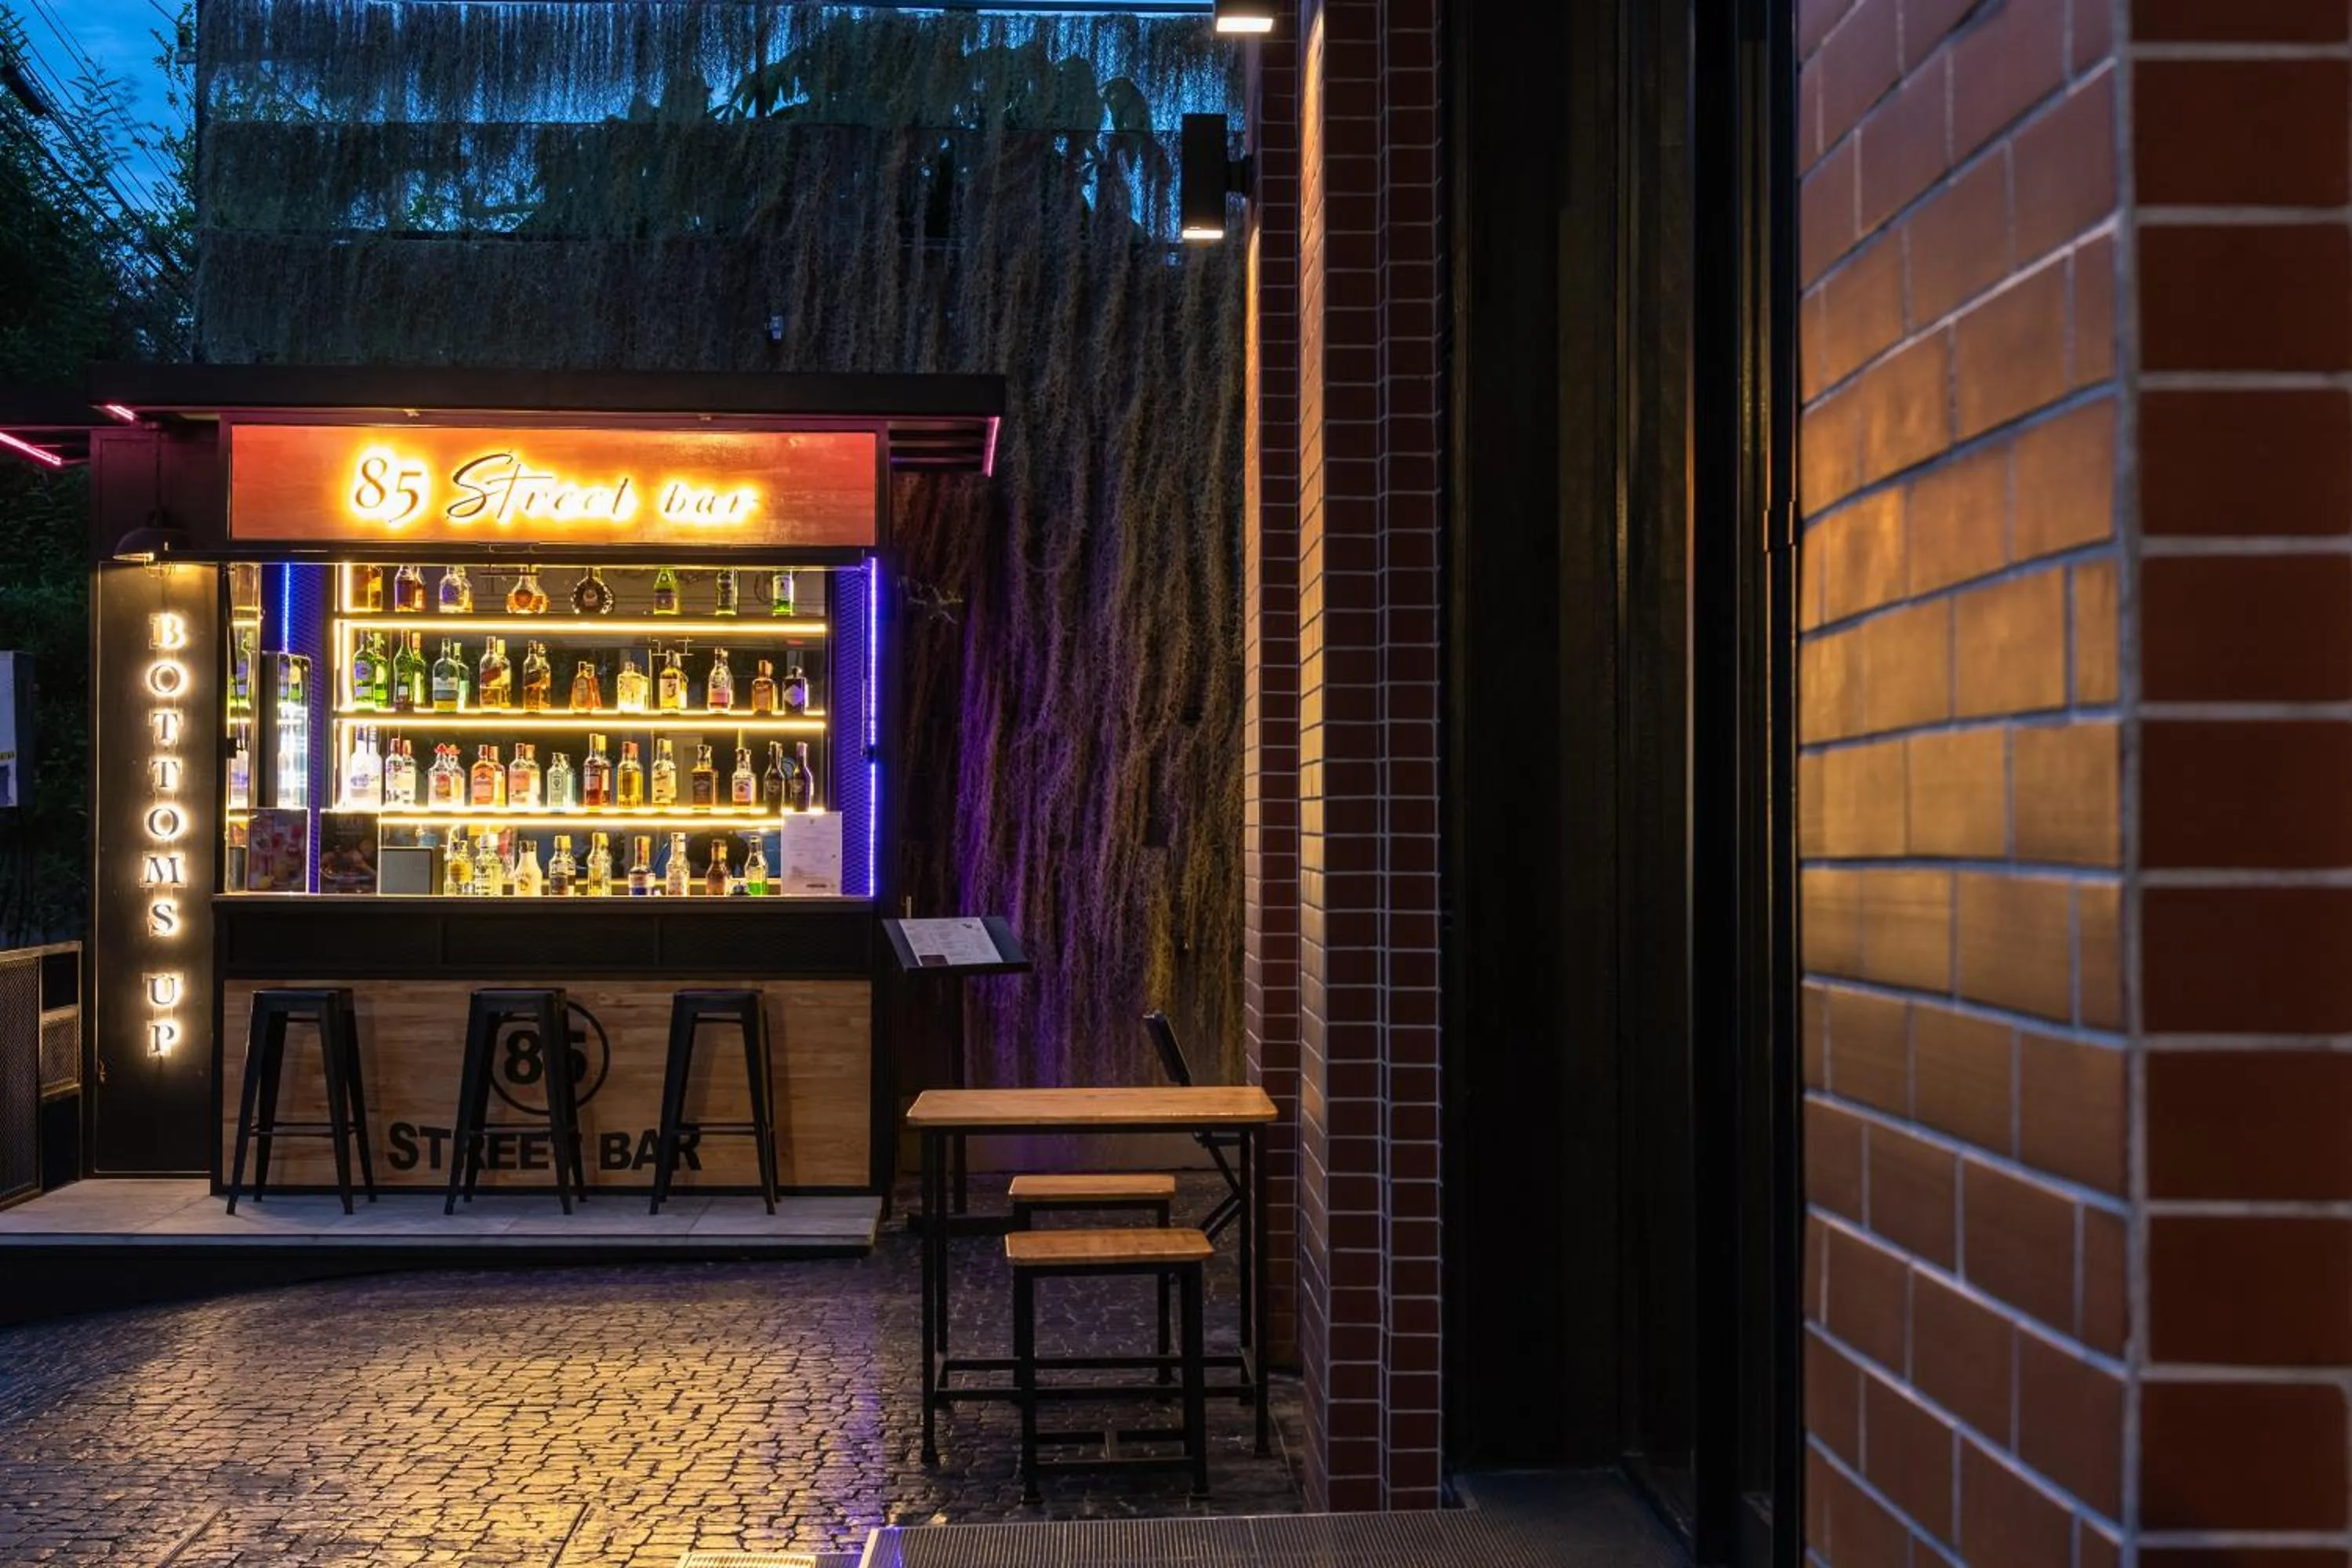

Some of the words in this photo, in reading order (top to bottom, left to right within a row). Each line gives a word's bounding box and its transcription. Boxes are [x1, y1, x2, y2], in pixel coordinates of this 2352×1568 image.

[355, 456, 423, 523] 85
[143, 614, 187, 935] BOTTOMS
[143, 973, 183, 1057] UP
